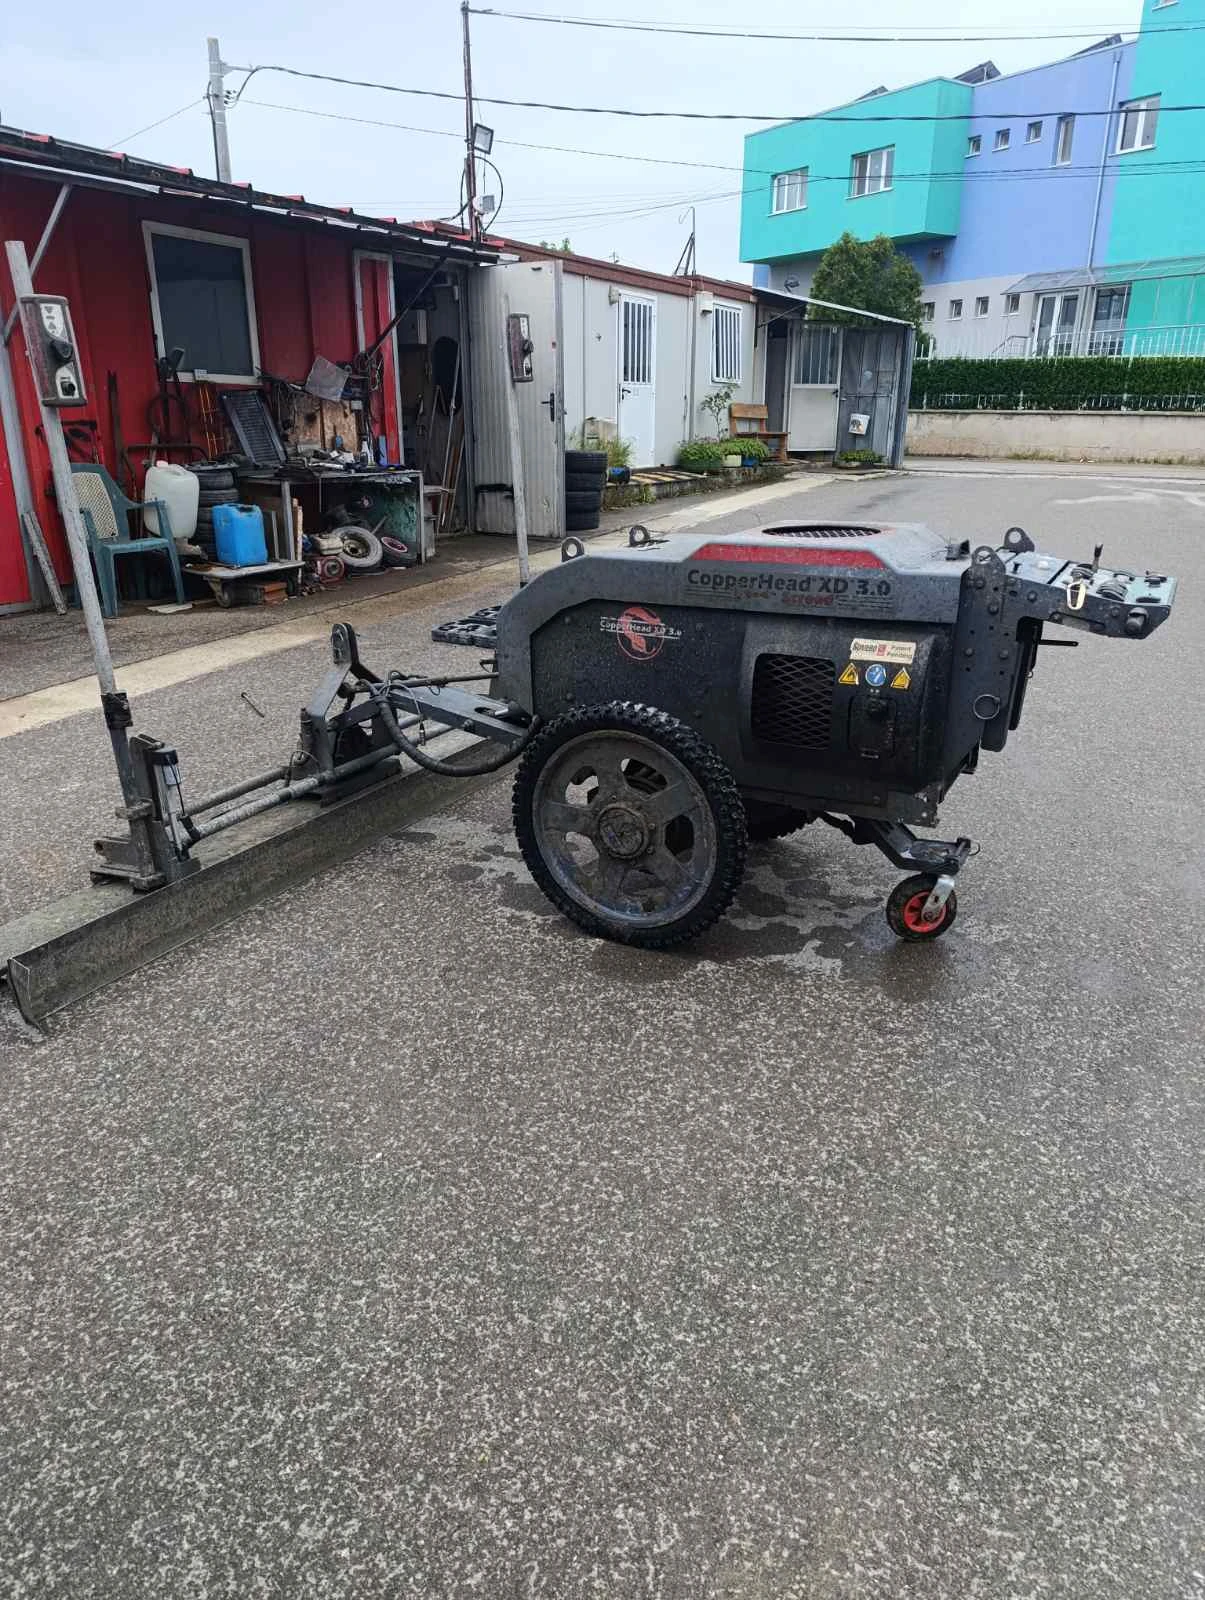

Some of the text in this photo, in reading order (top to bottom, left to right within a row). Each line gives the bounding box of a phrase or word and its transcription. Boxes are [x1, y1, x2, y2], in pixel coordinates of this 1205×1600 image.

[687, 569, 892, 597] CopperHead XD 3.0
